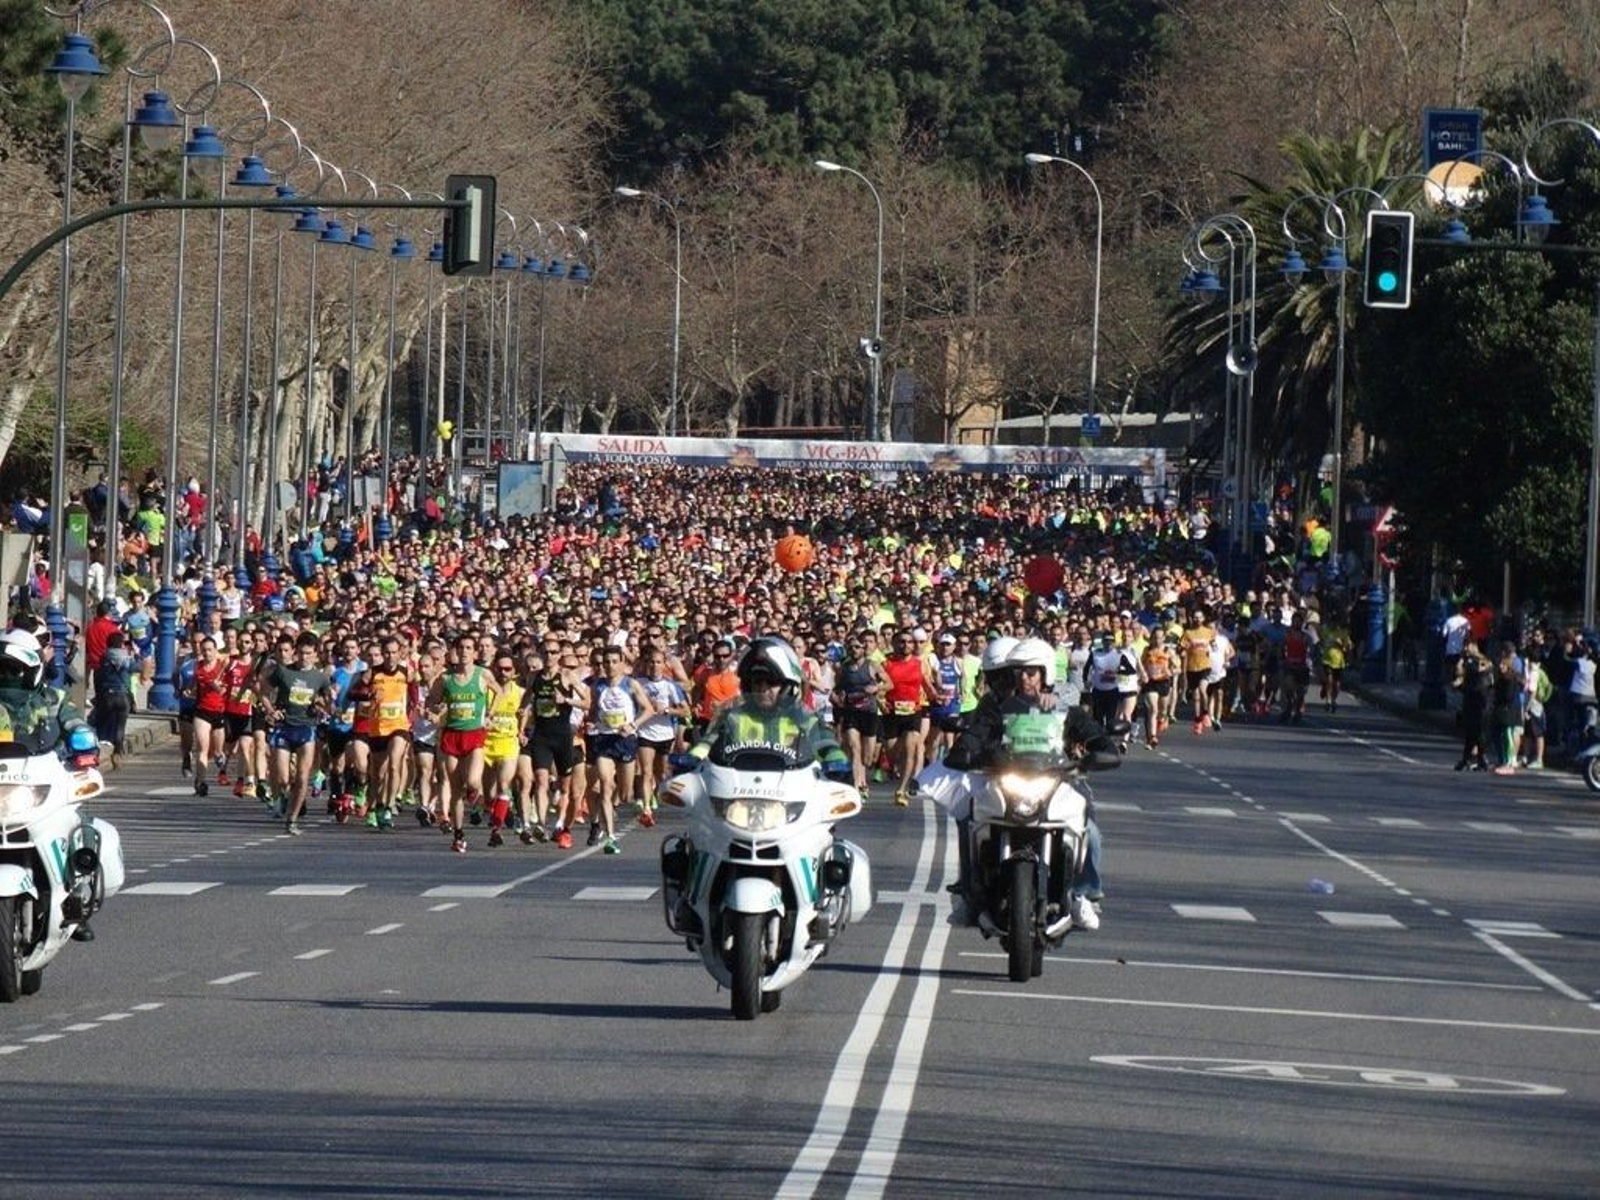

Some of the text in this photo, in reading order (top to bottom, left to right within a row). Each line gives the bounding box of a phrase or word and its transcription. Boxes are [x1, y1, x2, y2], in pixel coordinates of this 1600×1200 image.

[1430, 131, 1475, 141] HOTEL
[598, 438, 667, 453] SALIDA
[806, 444, 883, 461] VIG-BAY
[1015, 449, 1085, 464] SALIDA
[725, 739, 797, 759] GUARDIA CIVIL
